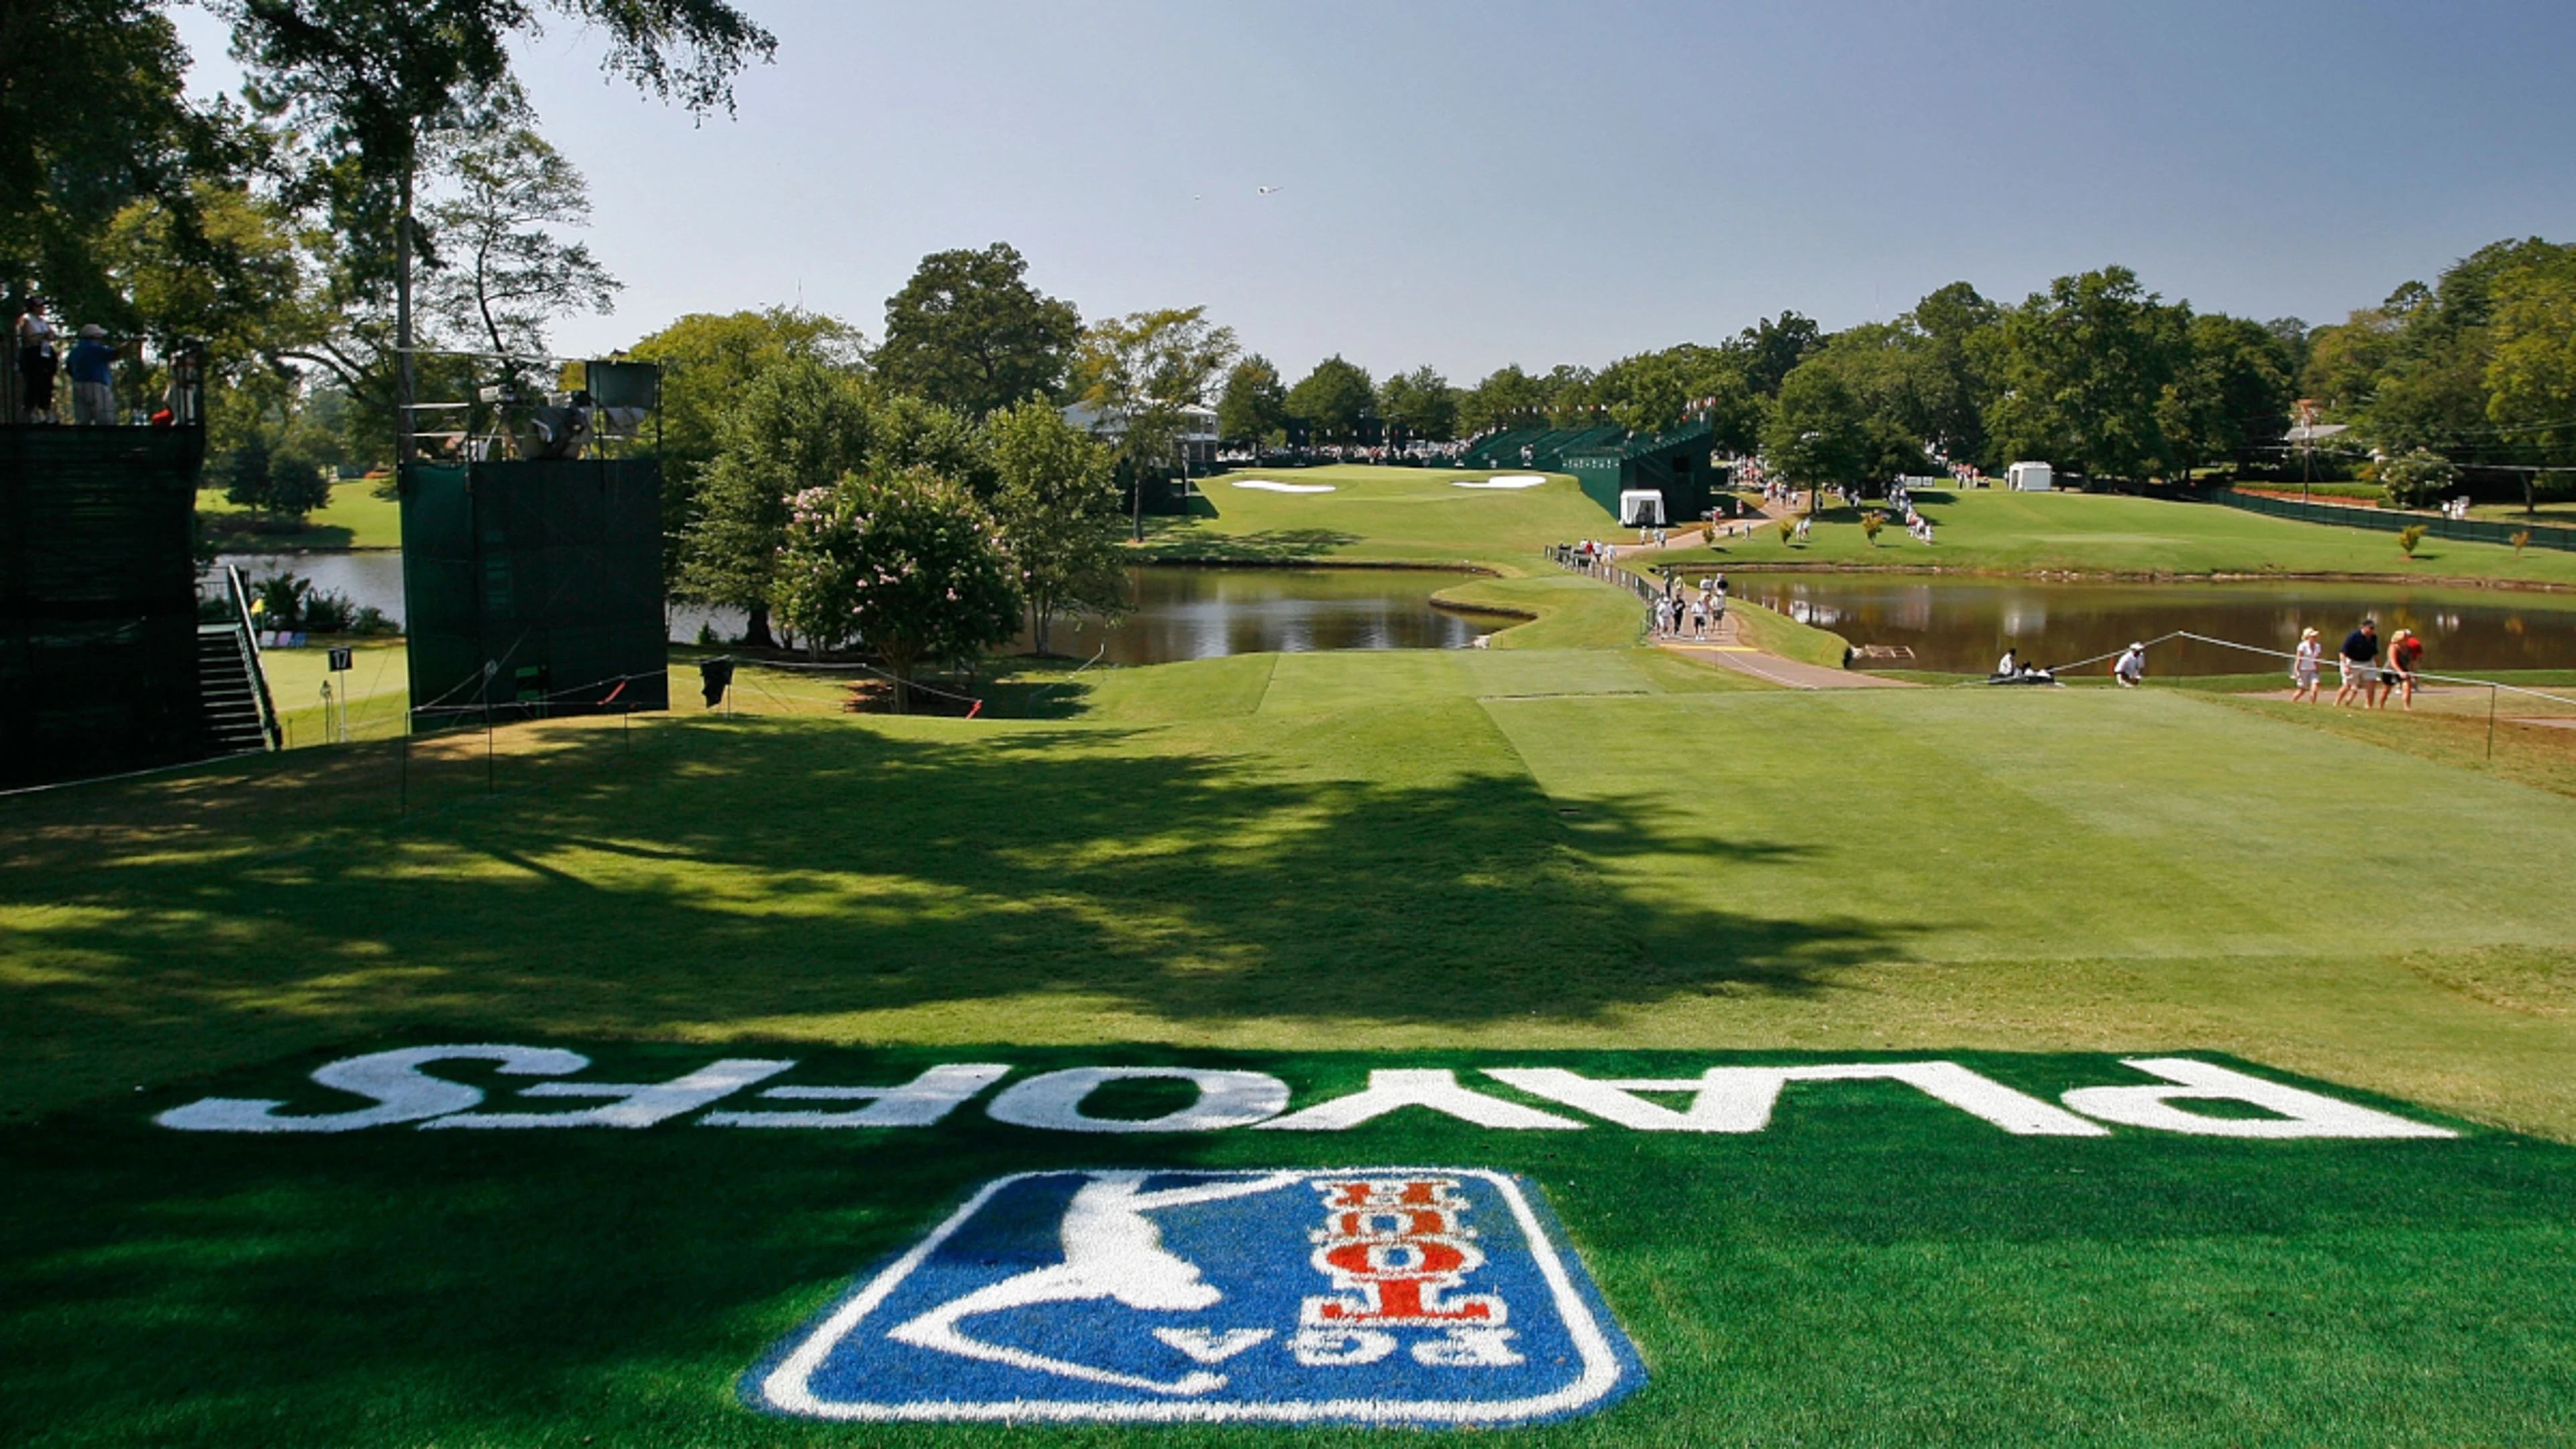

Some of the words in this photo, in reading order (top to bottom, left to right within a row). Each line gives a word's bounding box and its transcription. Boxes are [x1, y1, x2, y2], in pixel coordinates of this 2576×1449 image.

[333, 649, 348, 669] 17
[154, 1044, 2461, 1138] PLAYOFFS
[1299, 1179, 1507, 1327] TOUR
[1152, 1326, 1525, 1366] PGA
